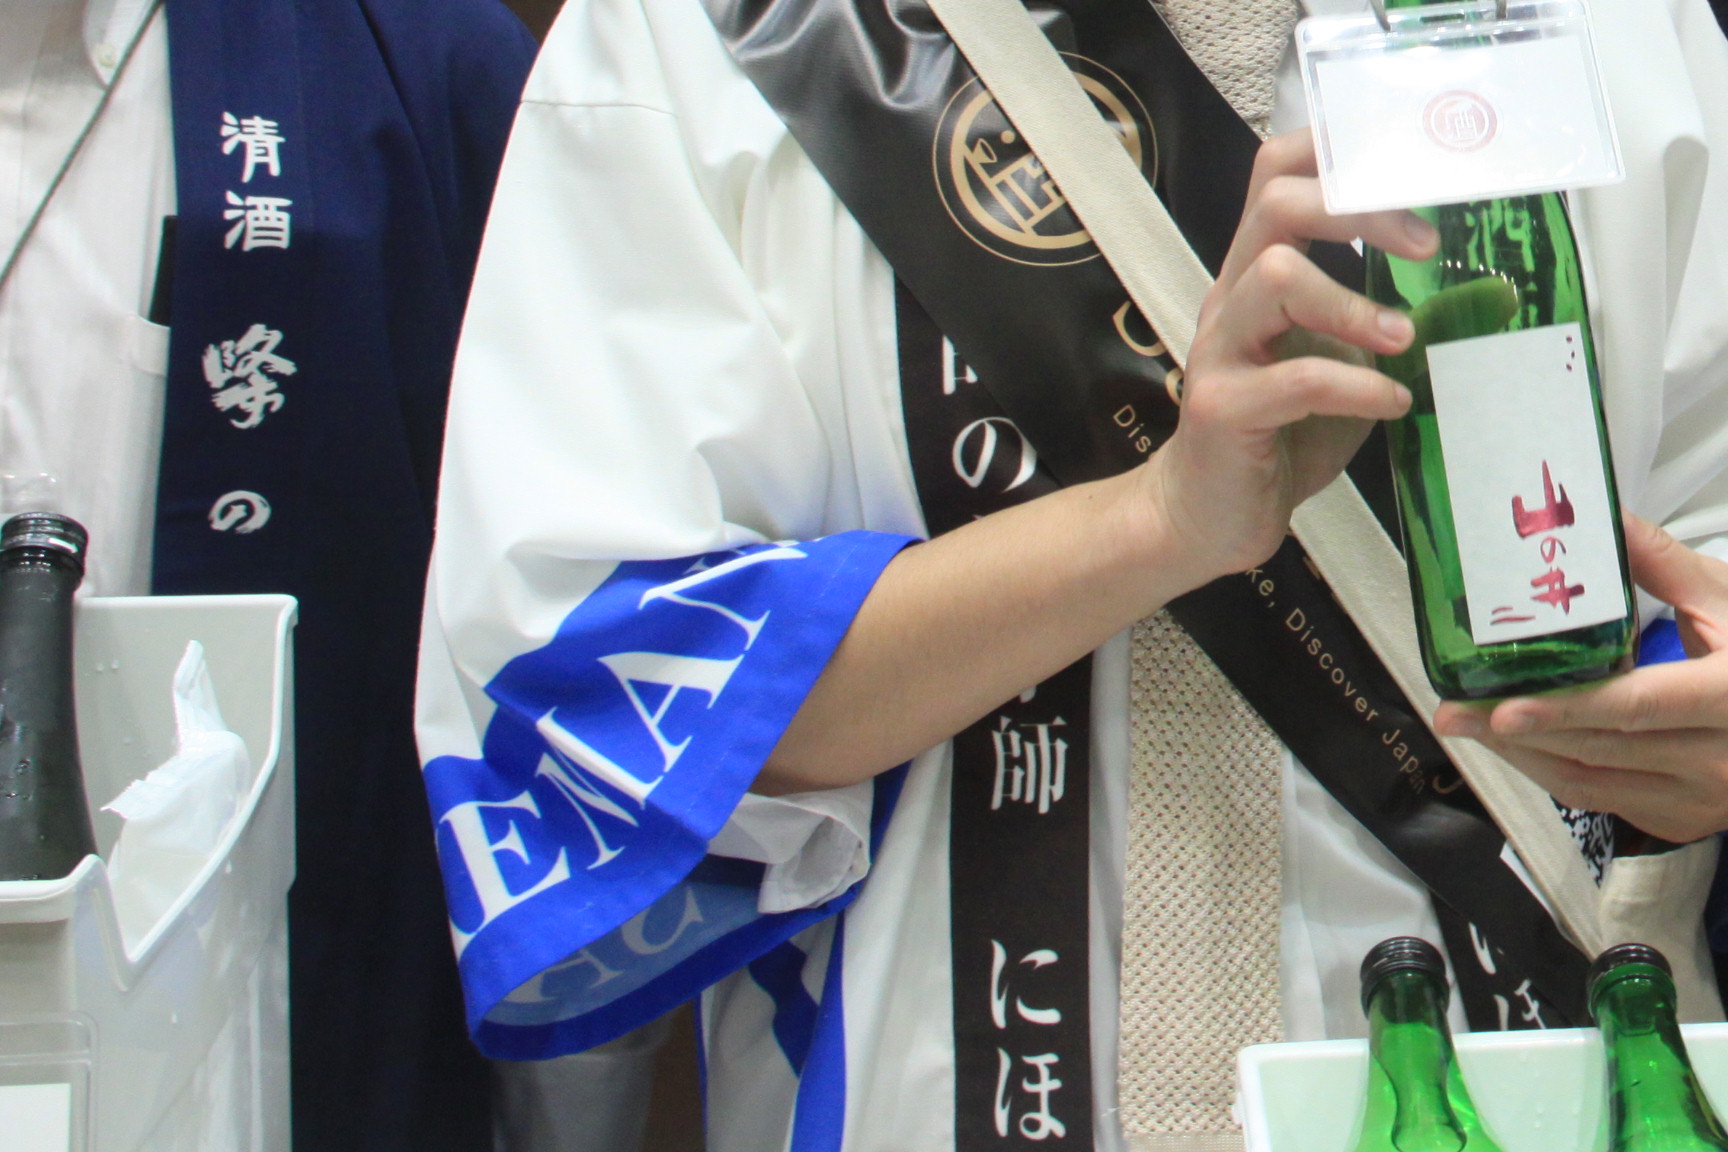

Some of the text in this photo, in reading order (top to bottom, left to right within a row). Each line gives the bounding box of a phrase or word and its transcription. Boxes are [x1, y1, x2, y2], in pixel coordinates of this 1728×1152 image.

[220, 110, 292, 252] 清酒
[1511, 459, 1585, 615] 山の井
[1285, 608, 1379, 722] Discover
